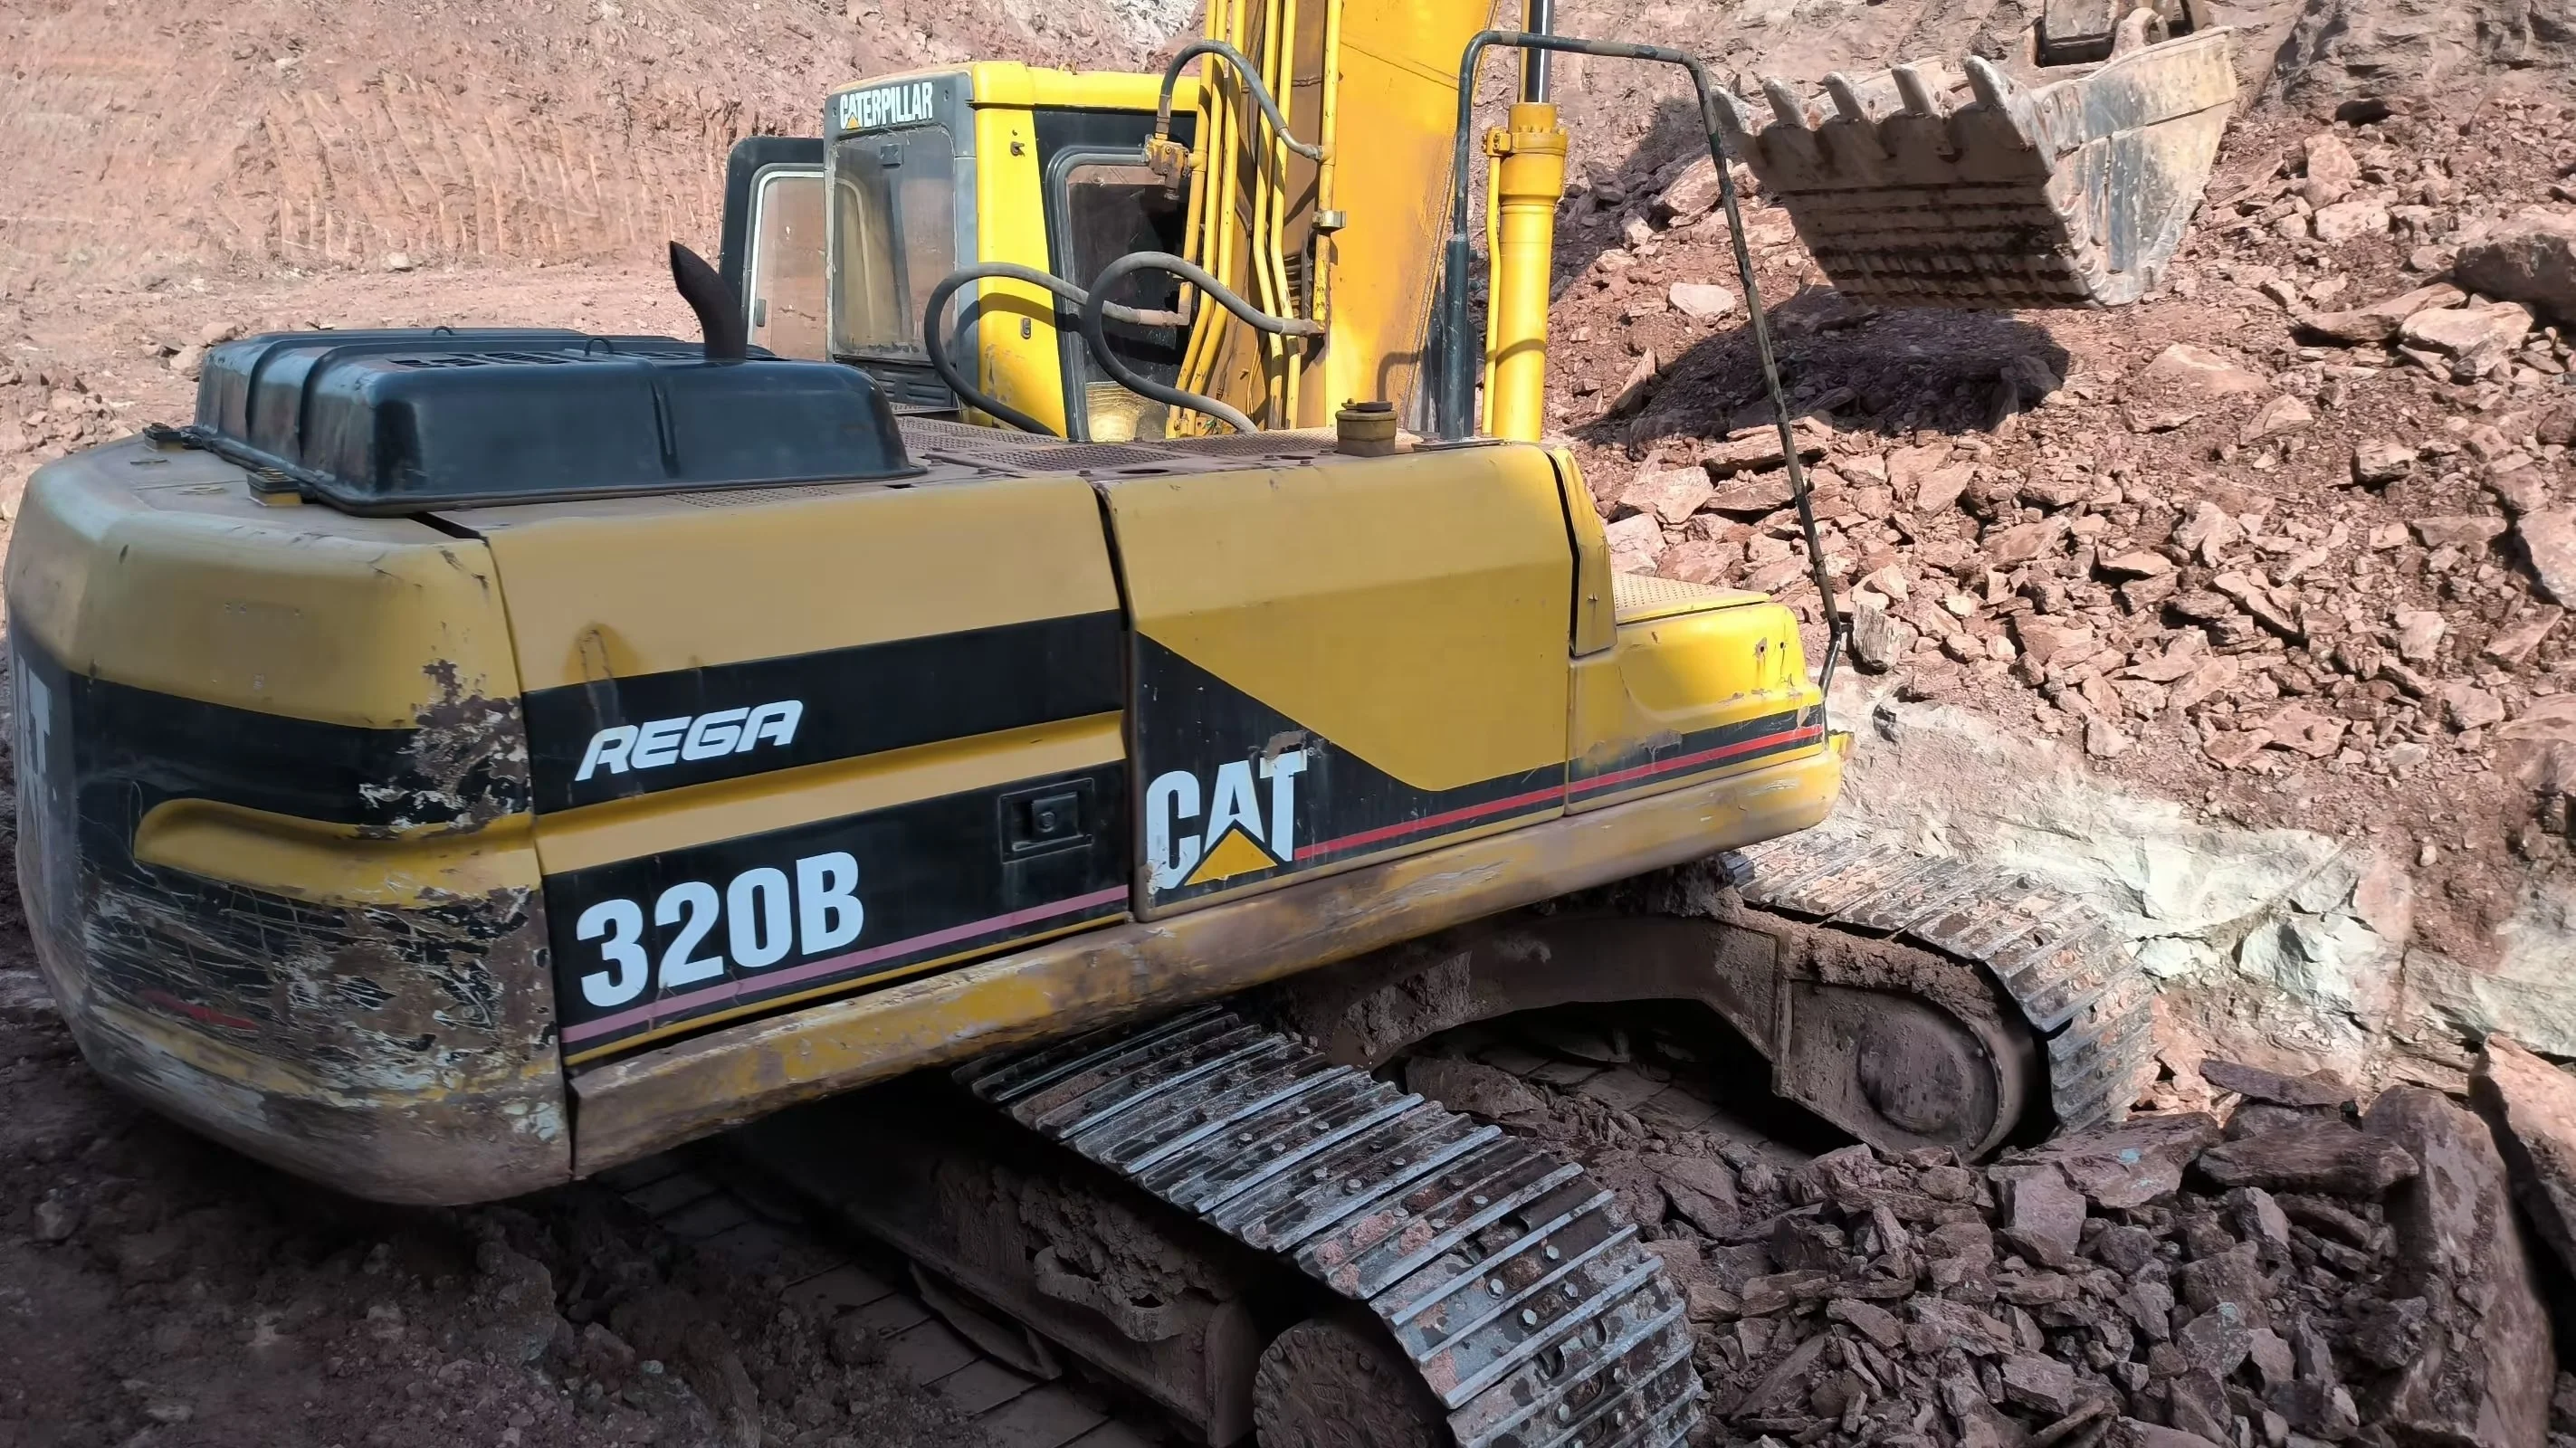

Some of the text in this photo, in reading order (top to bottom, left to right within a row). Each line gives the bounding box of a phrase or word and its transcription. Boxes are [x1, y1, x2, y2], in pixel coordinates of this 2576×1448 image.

[840, 81, 933, 129] CATERPILLAR
[575, 700, 804, 782] REGA
[1146, 748, 1308, 892] CAT
[576, 851, 864, 1008] 320B
